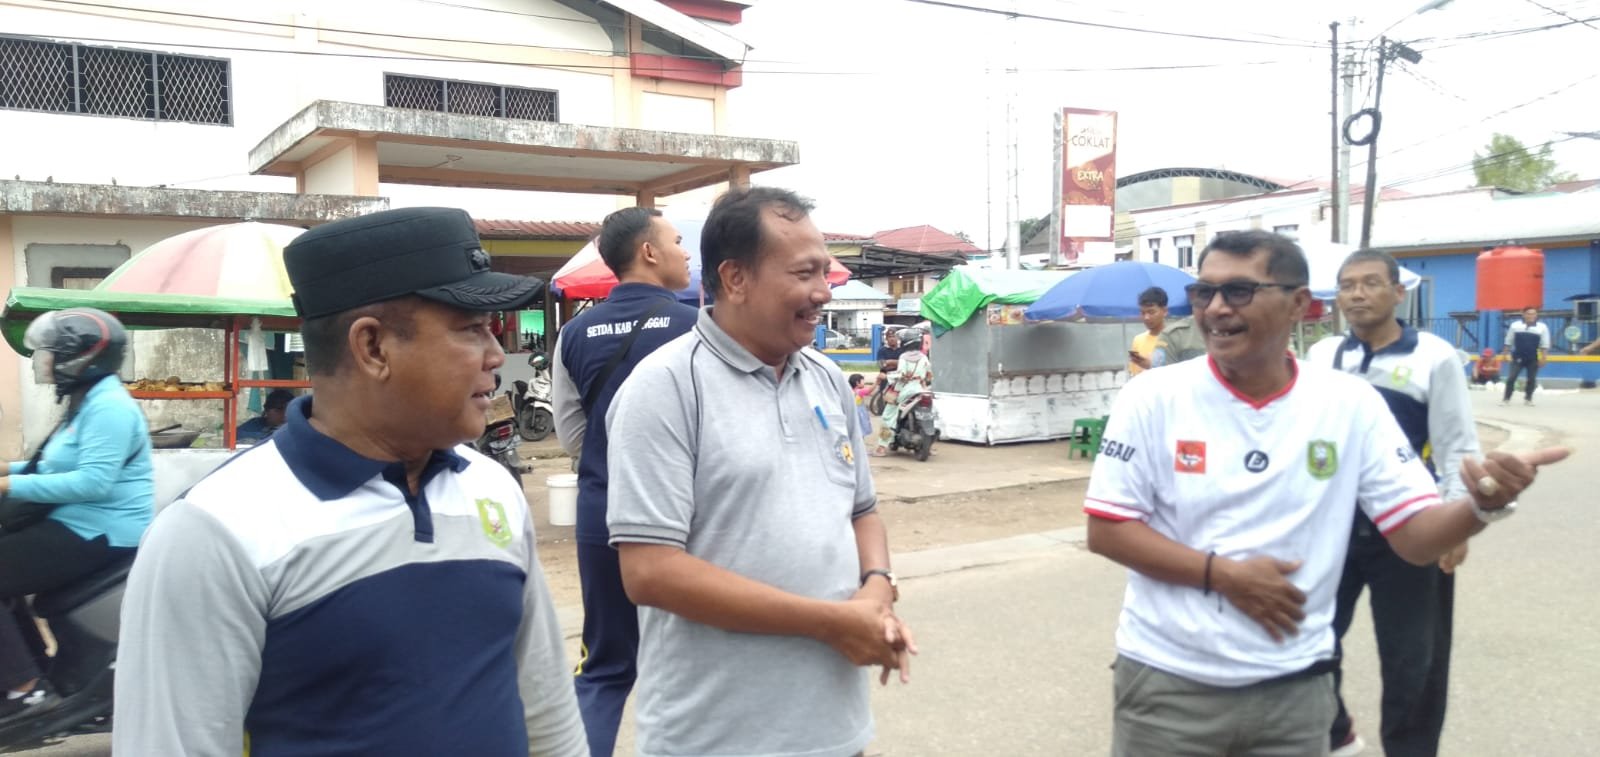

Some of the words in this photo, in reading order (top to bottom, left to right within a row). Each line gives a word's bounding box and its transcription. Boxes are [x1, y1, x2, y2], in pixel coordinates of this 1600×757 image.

[1071, 134, 1110, 148] COKLAT
[586, 323, 613, 338] SETDA
[615, 321, 632, 335] KAB
